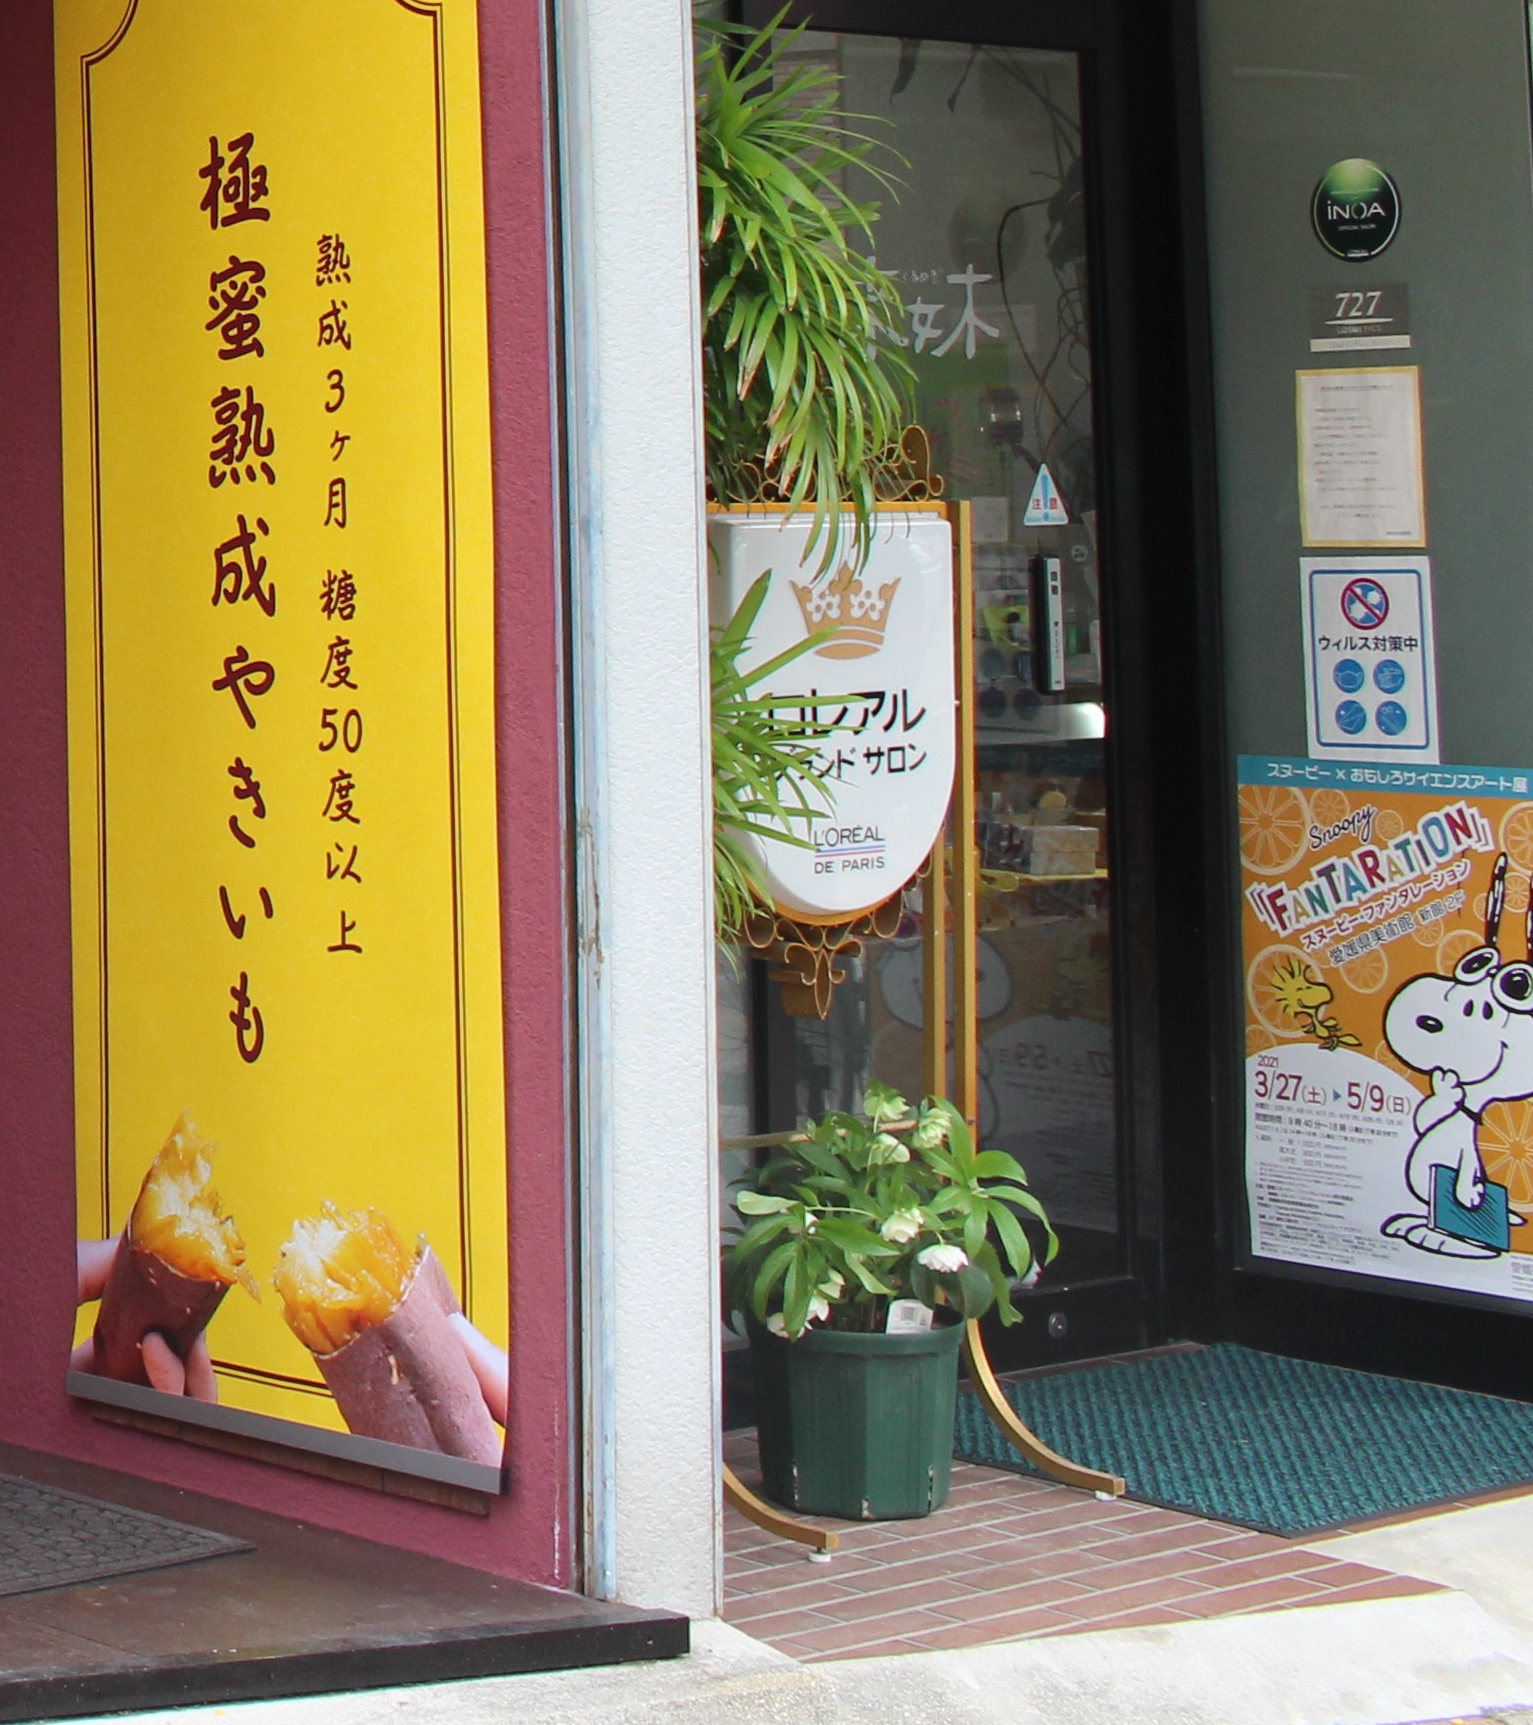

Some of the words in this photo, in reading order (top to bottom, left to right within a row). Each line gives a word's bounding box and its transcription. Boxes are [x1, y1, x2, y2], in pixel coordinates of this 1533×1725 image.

[1334, 290, 1383, 317] 727
[198, 131, 278, 1065] 極蜜熟成やきいも
[1318, 635, 1419, 652] ウィルス対策中
[769, 688, 927, 736] ロレアル
[316, 568, 365, 958] 糖度50度以上
[775, 744, 857, 781] ランド
[863, 742, 927, 776] サロン
[1267, 763, 1331, 778] スヌーピー
[1350, 767, 1529, 793] おもしろサイエンスアート展
[813, 825, 885, 847] L'ORÉAL
[1310, 805, 1376, 849] Snoopy
[814, 860, 834, 874] DE
[841, 856, 885, 872] PARIS
[1328, 913, 1415, 966] 愛媛県美術館
[1257, 1054, 1279, 1068] 2021
